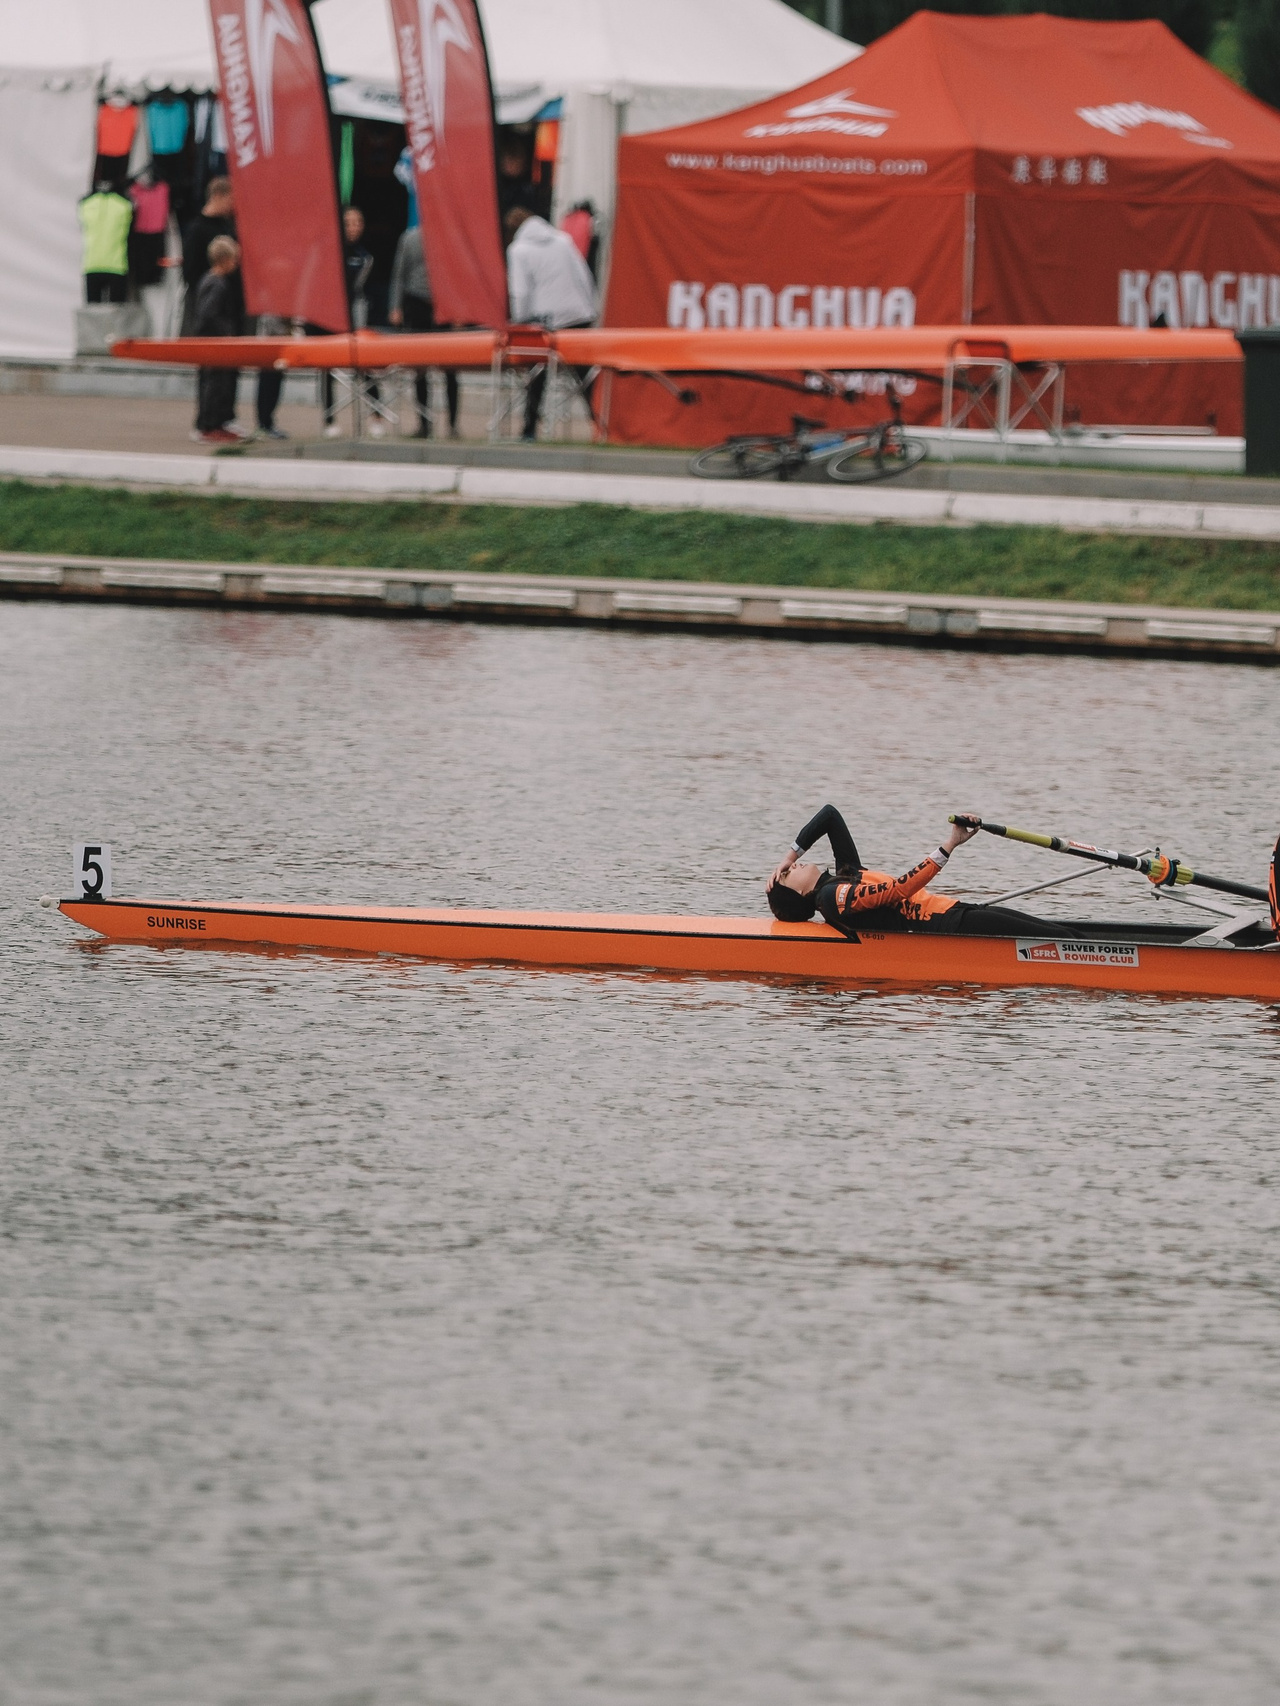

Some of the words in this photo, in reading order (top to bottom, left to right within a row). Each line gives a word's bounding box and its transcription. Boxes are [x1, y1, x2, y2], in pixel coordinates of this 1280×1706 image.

[667, 280, 917, 332] KANGHUA
[81, 846, 104, 895] 5
[147, 916, 207, 931] SUNRISE
[1033, 949, 1057, 958] SFRC
[1062, 943, 1096, 953] SILVER
[1098, 945, 1136, 955] FOREST
[1064, 953, 1107, 963] ROWING
[1109, 955, 1134, 964] CLUB
